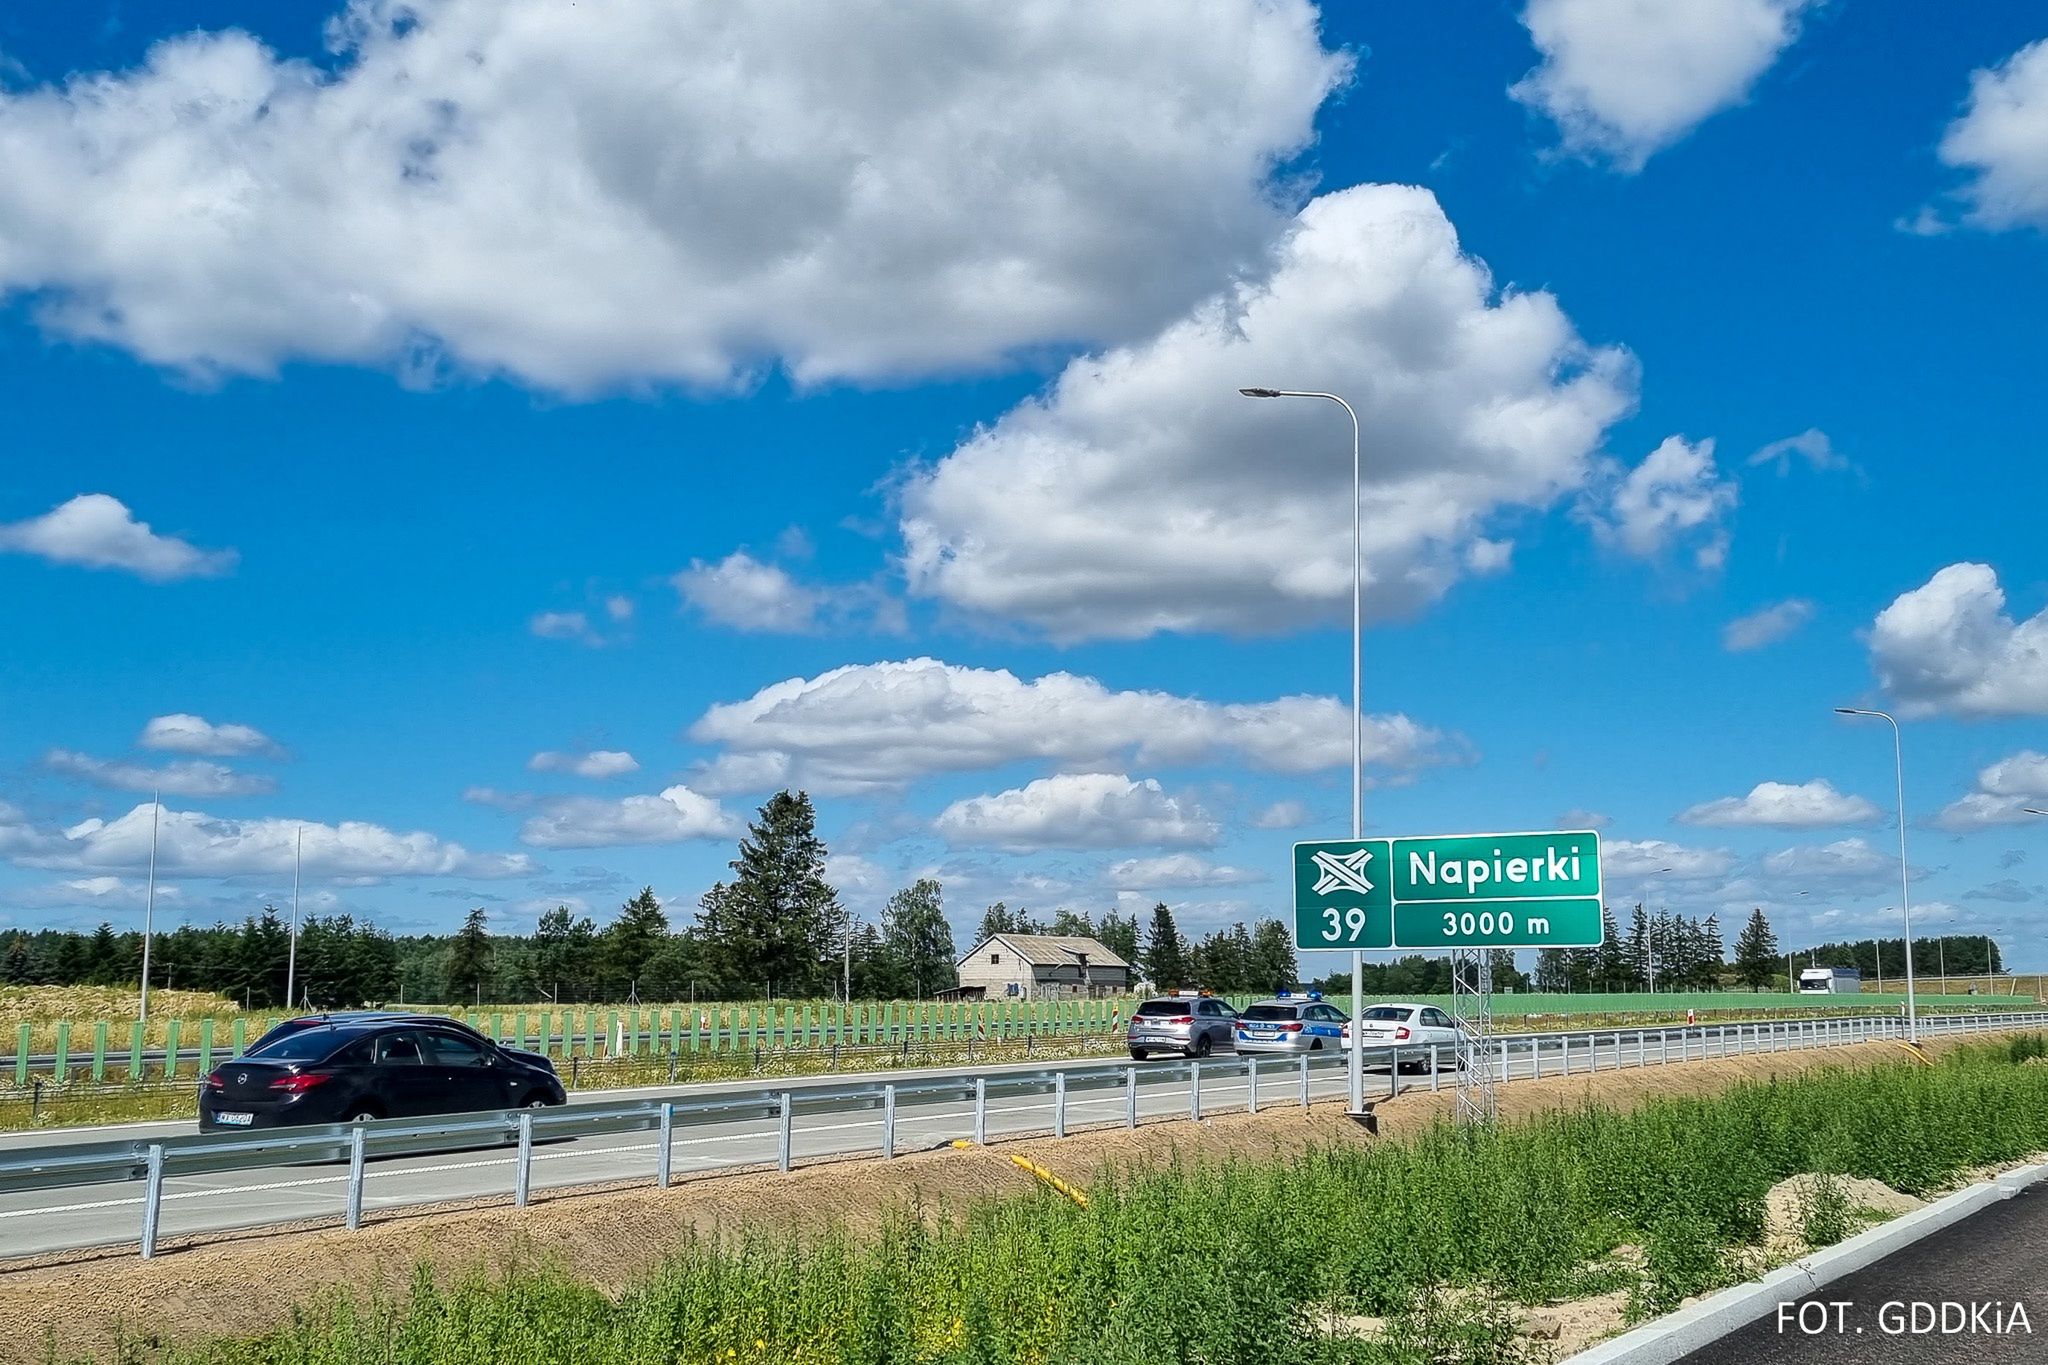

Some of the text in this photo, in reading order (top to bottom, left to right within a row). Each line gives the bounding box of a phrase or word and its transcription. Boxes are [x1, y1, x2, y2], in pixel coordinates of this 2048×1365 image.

[1409, 846, 1580, 894] Napierki
[1321, 907, 1366, 942] 39
[1442, 911, 1550, 936] 3000 m
